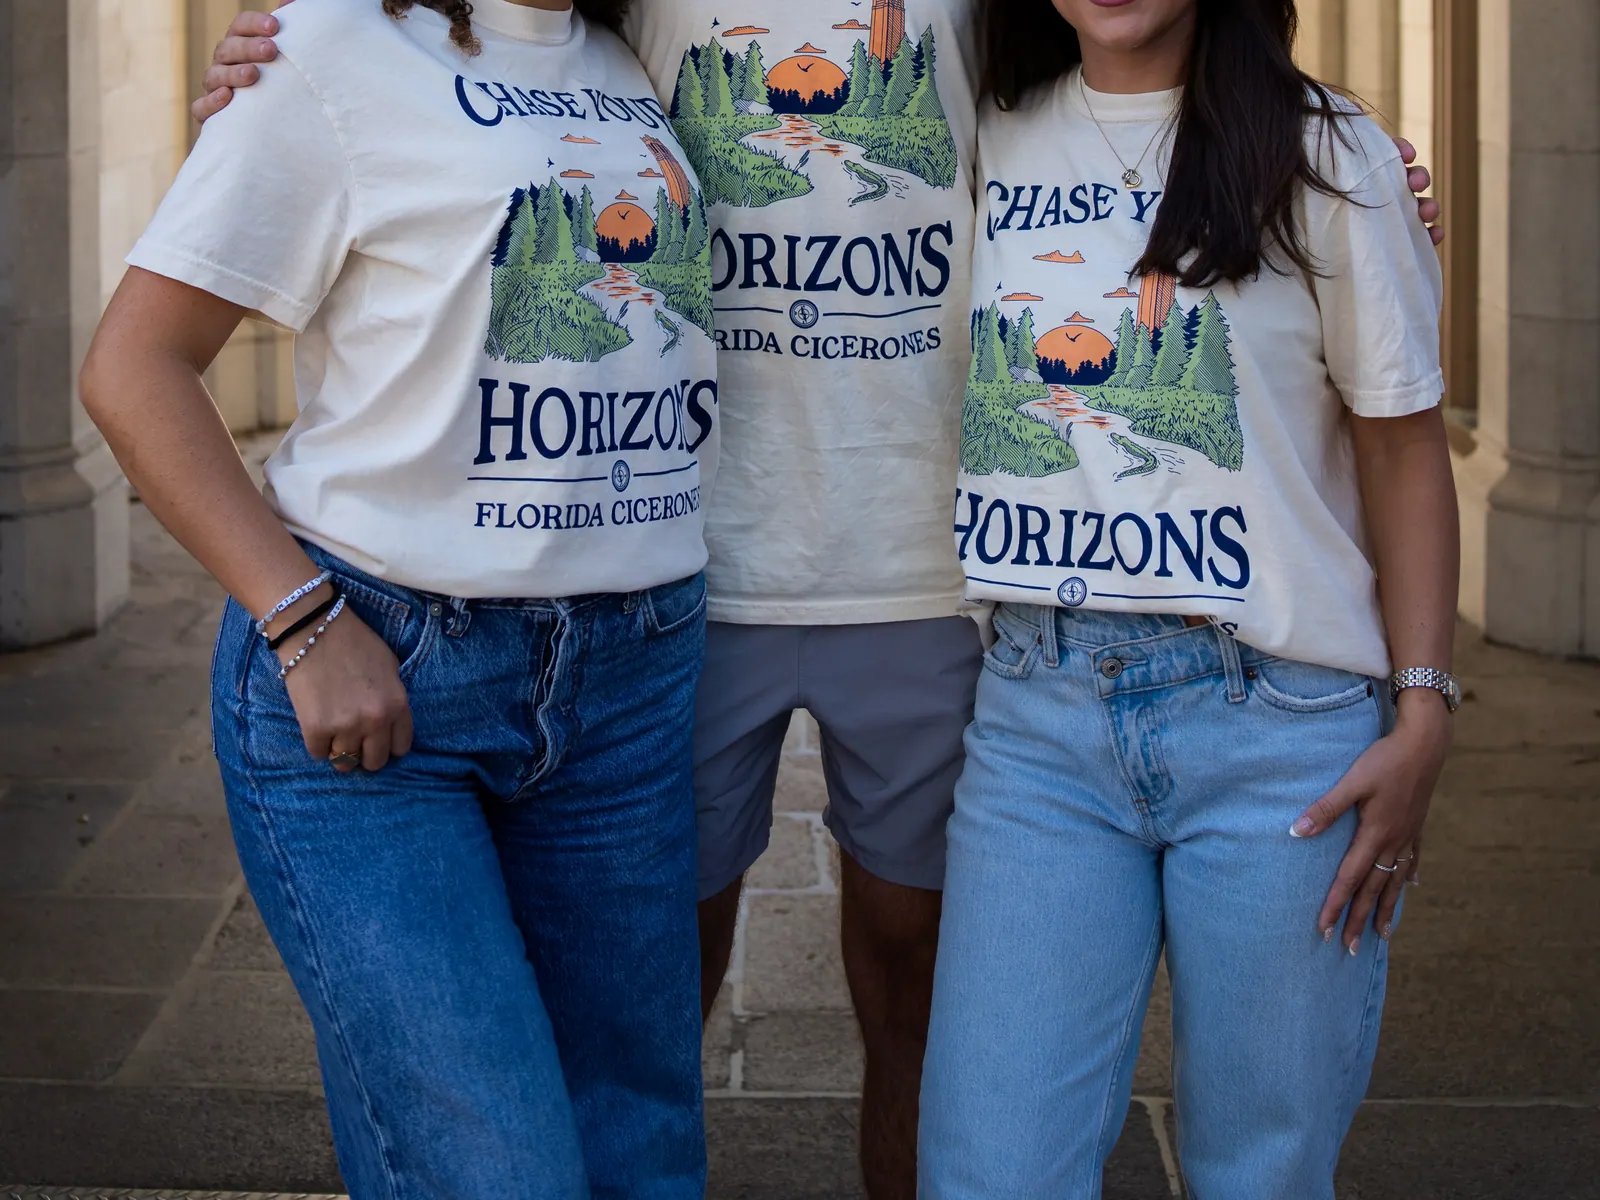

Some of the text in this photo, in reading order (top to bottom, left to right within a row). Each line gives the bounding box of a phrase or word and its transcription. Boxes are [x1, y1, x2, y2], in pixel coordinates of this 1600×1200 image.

[455, 74, 587, 127] CHASE
[986, 180, 1118, 242] CHASE
[711, 221, 954, 298] ORIZONS
[714, 326, 942, 360] RIDA CICERONES
[474, 378, 718, 466] HORIZONS
[475, 502, 605, 530] FLORIDA
[954, 487, 1250, 590] HORIZONS
